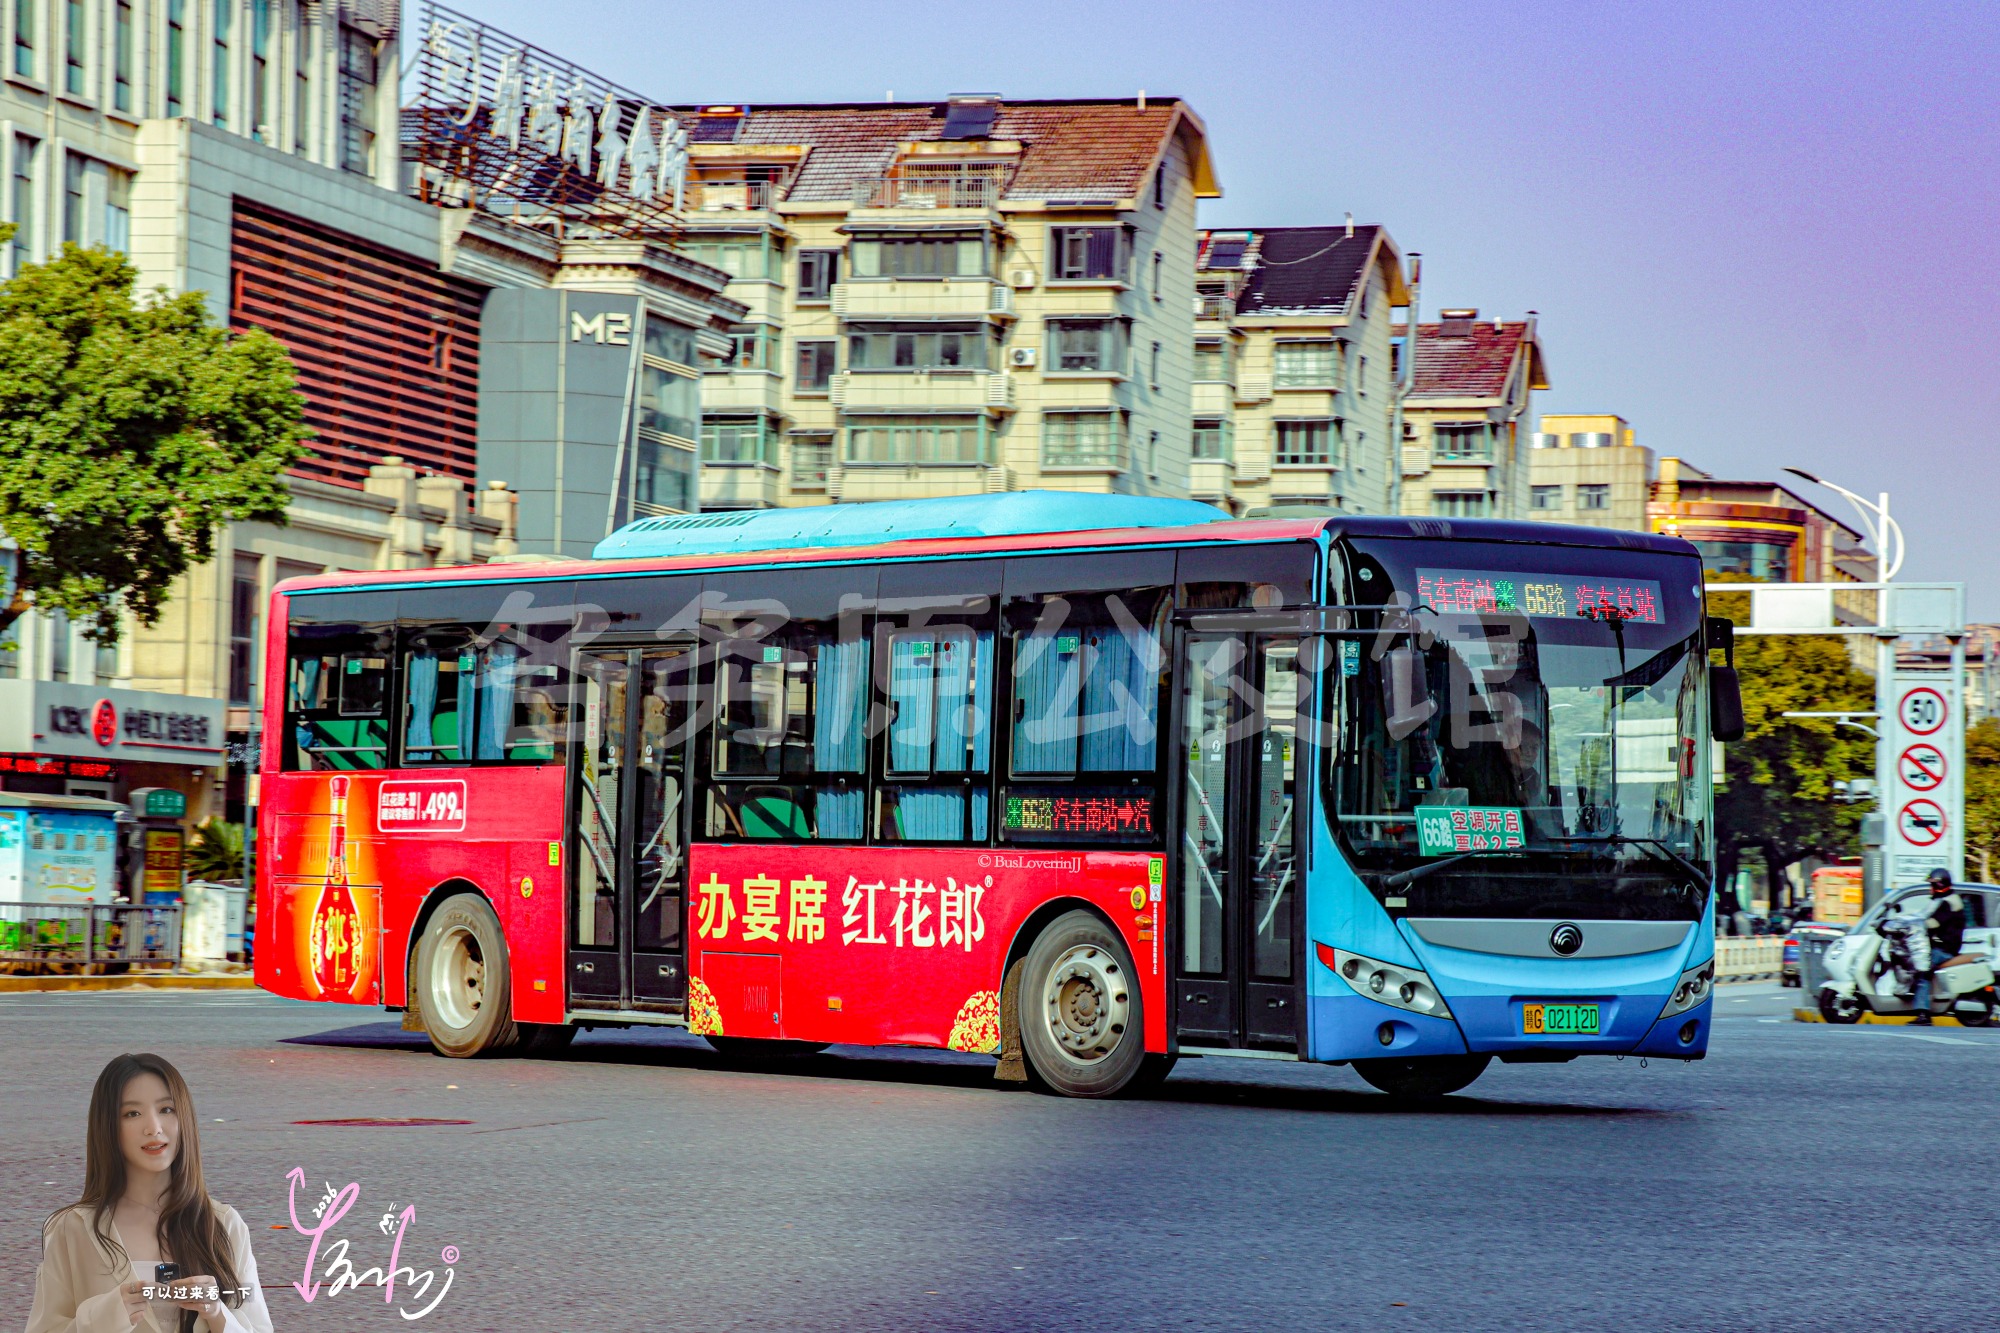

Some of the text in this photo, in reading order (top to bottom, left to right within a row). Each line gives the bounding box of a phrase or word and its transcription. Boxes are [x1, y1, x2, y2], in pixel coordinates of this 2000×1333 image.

[571, 310, 632, 345] M2
[1524, 583, 1567, 617] 66路
[1910, 699, 1937, 725] 50
[1423, 818, 1453, 847] 66路
[1450, 810, 1520, 832] 空调开启
[697, 873, 986, 952] 办宴席 红花郎
